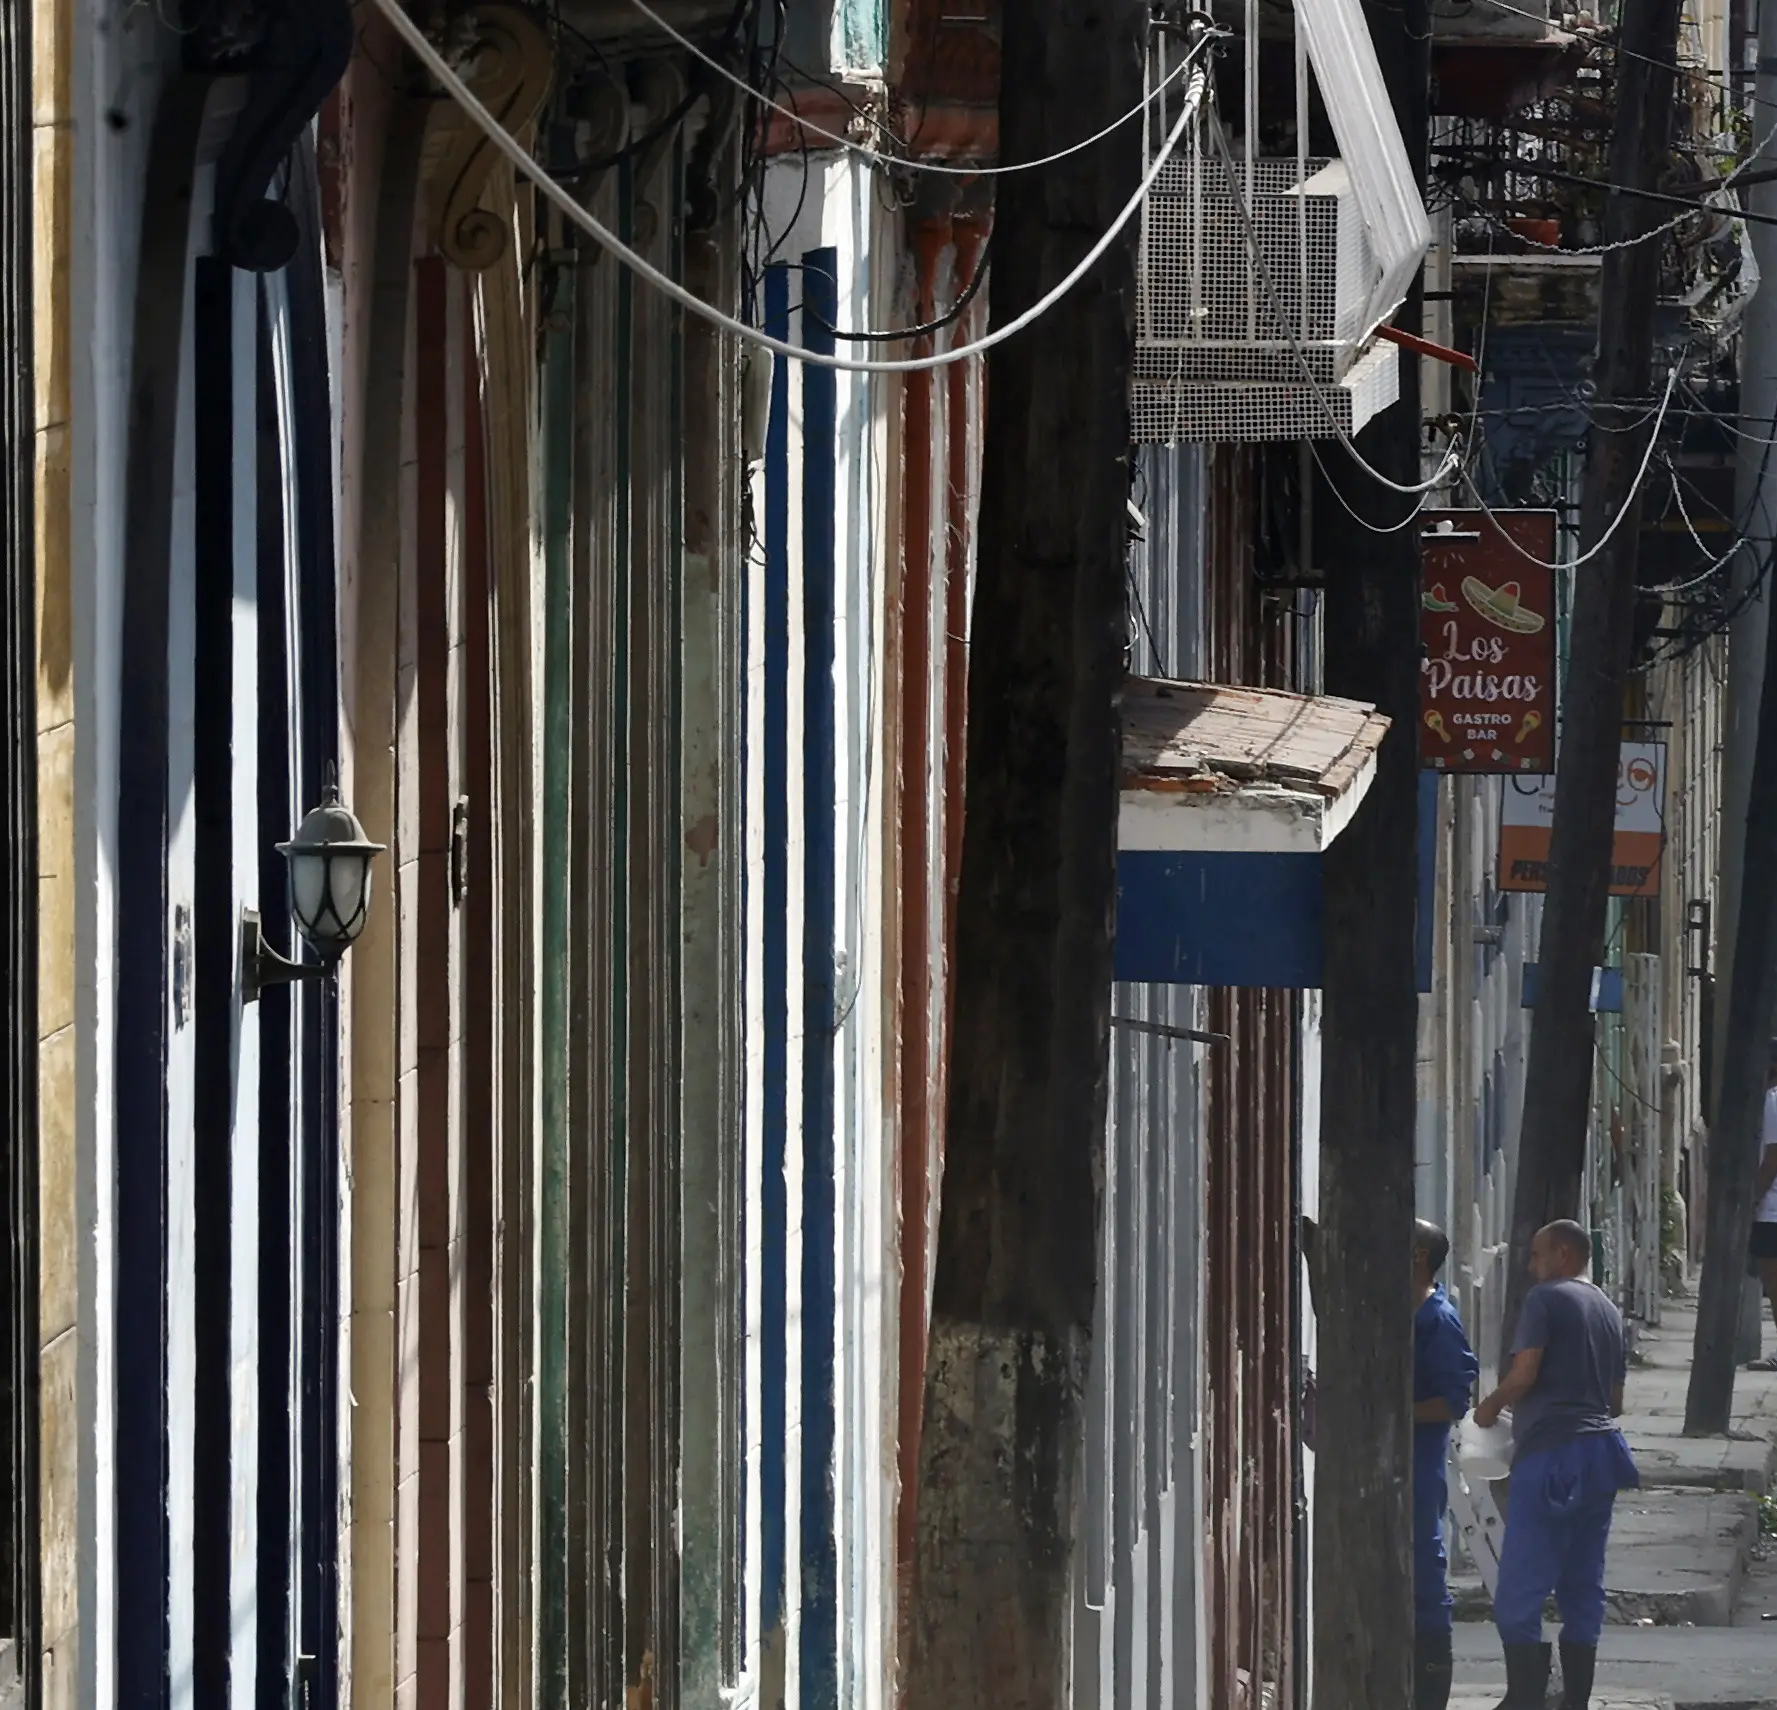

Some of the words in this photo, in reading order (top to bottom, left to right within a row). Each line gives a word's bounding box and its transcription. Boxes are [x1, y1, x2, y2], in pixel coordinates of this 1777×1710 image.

[1442, 621, 1510, 664] Los
[1426, 658, 1543, 701] Paisas
[1453, 713, 1512, 725] GASTRO
[1467, 729, 1497, 740] BAR
